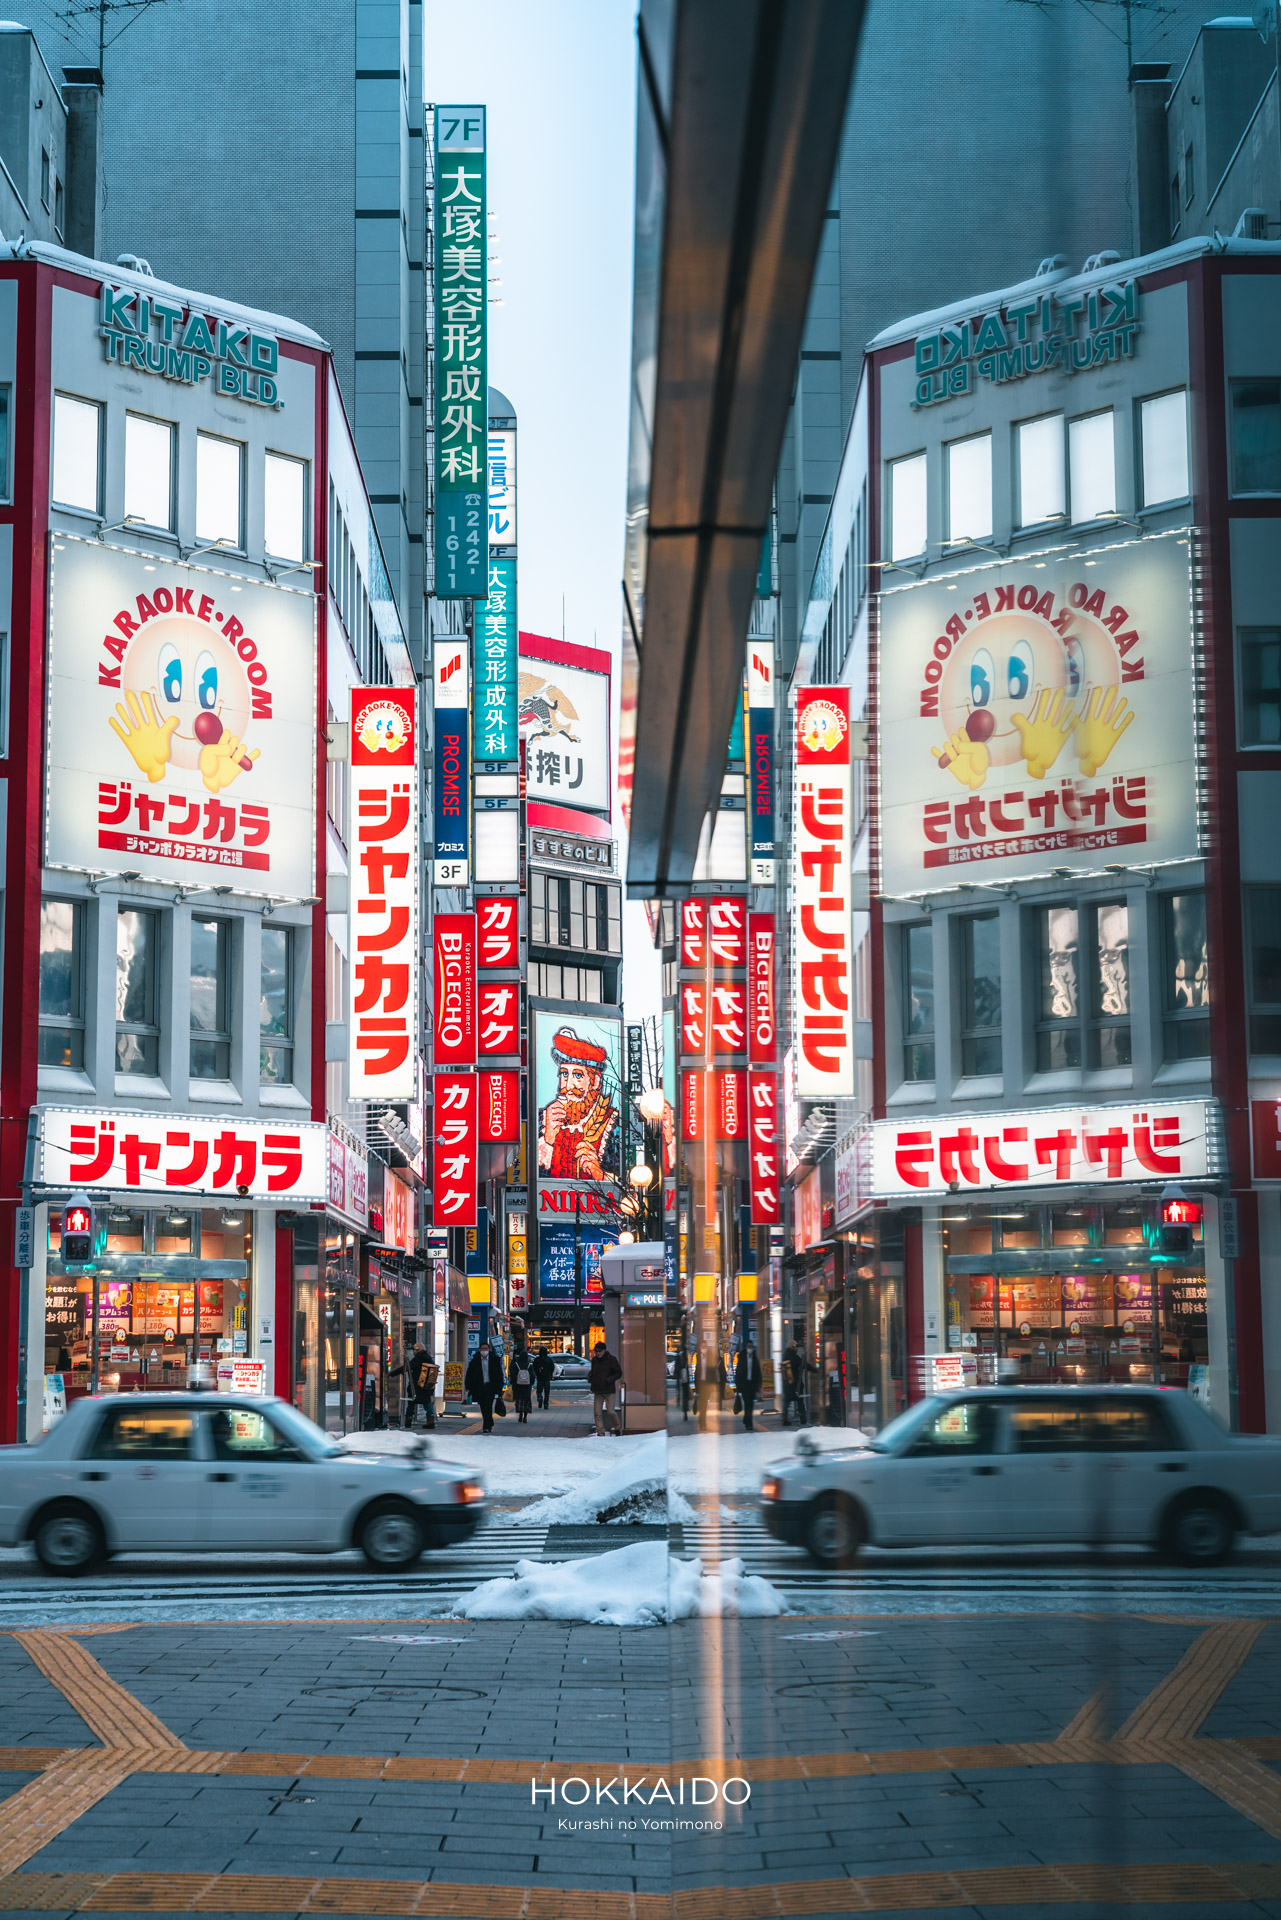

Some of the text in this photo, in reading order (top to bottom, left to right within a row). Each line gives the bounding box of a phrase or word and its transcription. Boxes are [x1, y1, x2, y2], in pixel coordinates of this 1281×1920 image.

[441, 119, 480, 141] 7F
[102, 284, 279, 374] KITAKO
[441, 166, 482, 483] 大塚美容形成外科
[105, 328, 285, 411] TRUMP BLD.
[488, 438, 510, 535] 三信ビル
[484, 566, 508, 754] 大塚美容形成外科
[442, 734, 460, 816] PROMISE
[484, 762, 508, 772] 5F
[98, 781, 271, 848] ジャンカラ
[484, 800, 508, 809] 5F
[126, 836, 243, 867] ジャンボカラオケ広場
[437, 842, 465, 852] プロミス
[441, 866, 461, 879] 3F
[533, 838, 608, 864] すすきのビル
[355, 783, 411, 1076] ジャンカラ
[440, 933, 463, 1047] BIG ECHO
[481, 903, 514, 1049] カラオケ
[490, 1075, 503, 1137] BIG ECHO
[69, 1120, 303, 1192] ジャンカラ
[439, 1083, 470, 1215] カラオケ
[18, 1210, 30, 1266] 歩車分離式
[543, 1257, 575, 1267] ハイボー
[511, 1278, 525, 1308] 串鳥
[643, 1295, 662, 1304] POLE
